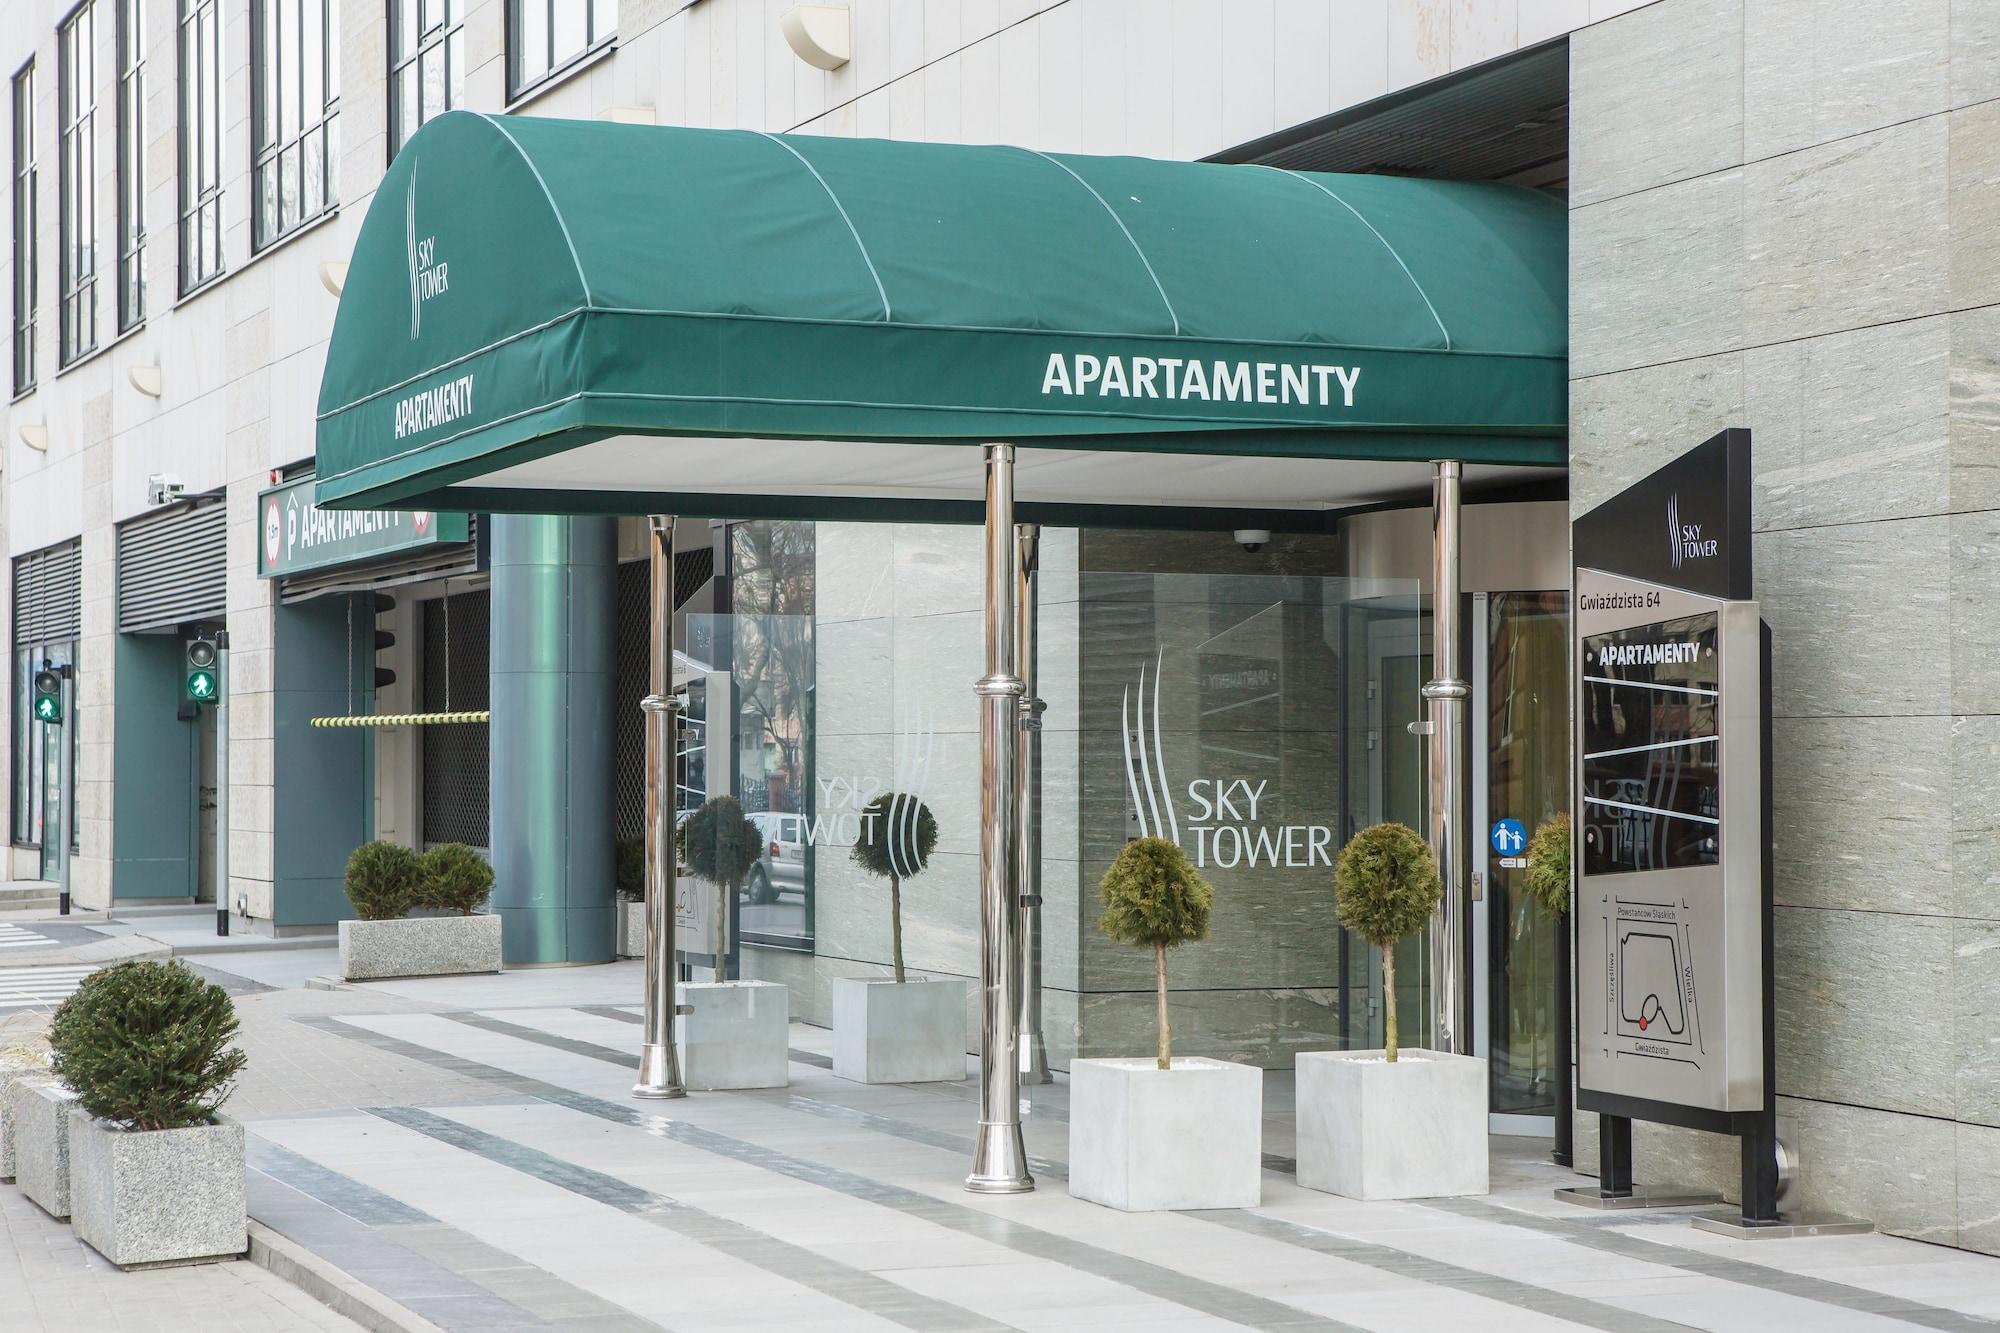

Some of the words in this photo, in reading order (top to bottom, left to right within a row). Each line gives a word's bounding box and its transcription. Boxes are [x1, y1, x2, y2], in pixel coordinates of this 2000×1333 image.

[419, 235, 435, 271] SKY
[419, 262, 449, 302] TOWER
[1042, 353, 1361, 407] APARTAMENTY
[395, 374, 474, 440] APARTAMENTY
[1682, 525, 1702, 542] SKY
[1682, 540, 1718, 559] TOWER
[1580, 592, 1643, 611] Gwiaździsta
[1646, 591, 1661, 608] 64
[1599, 642, 1700, 667] APARTAMENTY
[1188, 779, 1268, 822] SKY
[1187, 825, 1333, 869] TOWER
[1684, 966, 1693, 1003] Wielka
